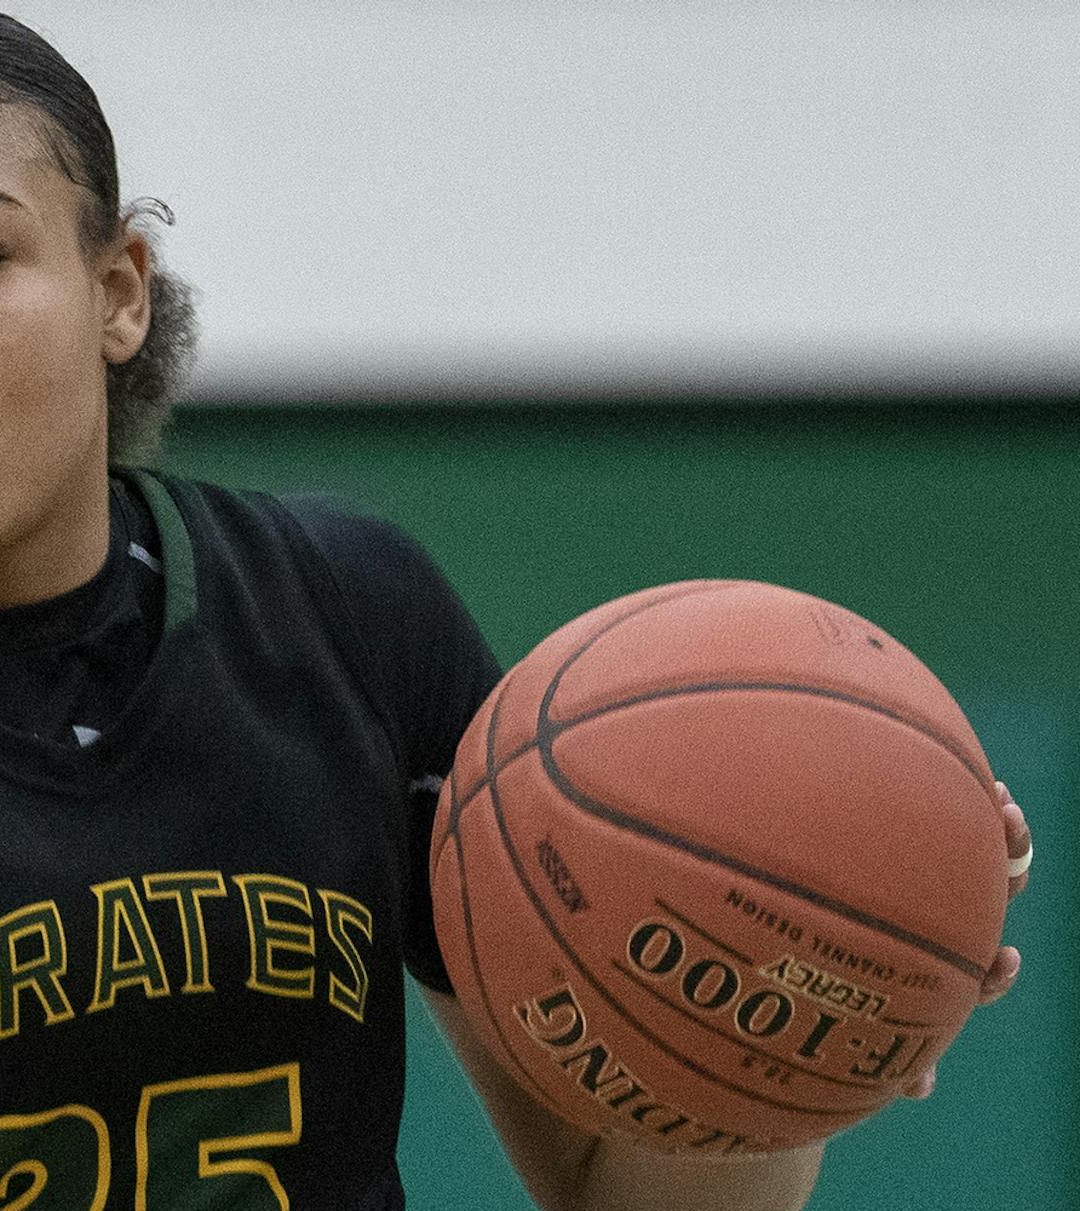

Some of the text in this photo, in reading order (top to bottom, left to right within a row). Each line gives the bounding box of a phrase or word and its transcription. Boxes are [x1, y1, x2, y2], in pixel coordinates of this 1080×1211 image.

[724, 887, 807, 944] DESIGN
[758, 954, 890, 1020] LEGACY
[809, 935, 896, 983] CHANNEL
